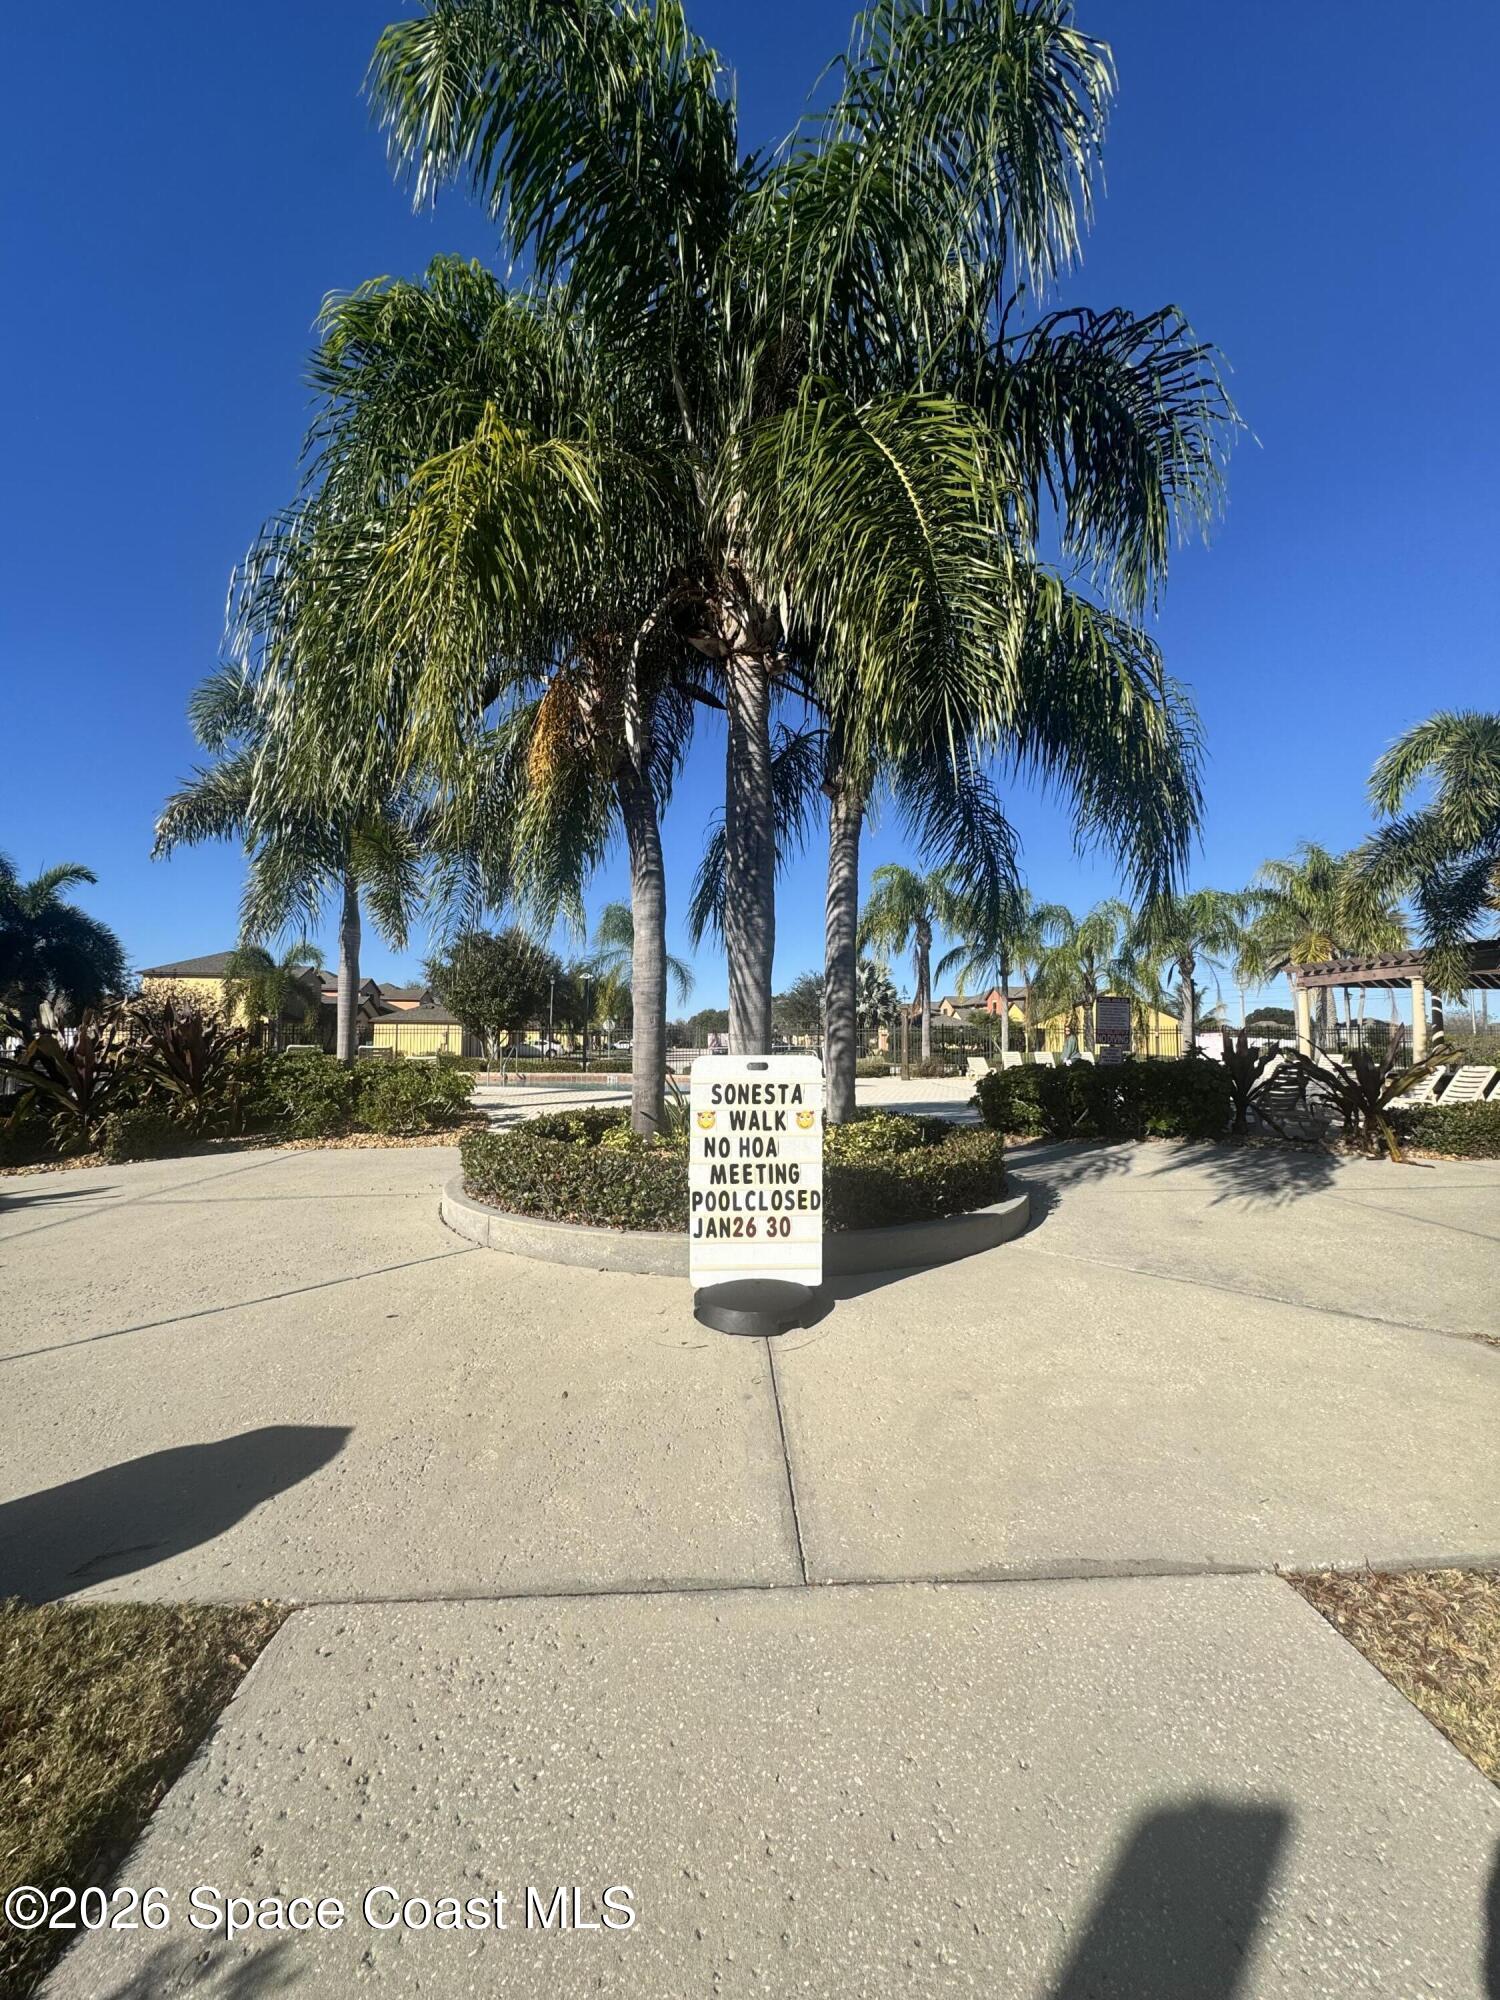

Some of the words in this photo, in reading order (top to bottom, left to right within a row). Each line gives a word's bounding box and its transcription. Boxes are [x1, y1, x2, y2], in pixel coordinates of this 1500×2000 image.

[711, 1083, 803, 1105] SONESTA
[729, 1110, 787, 1131] WALK
[704, 1136, 731, 1158] NO
[739, 1136, 778, 1158] HOA
[709, 1163, 800, 1185] MEETING
[766, 1216, 791, 1238] 30
